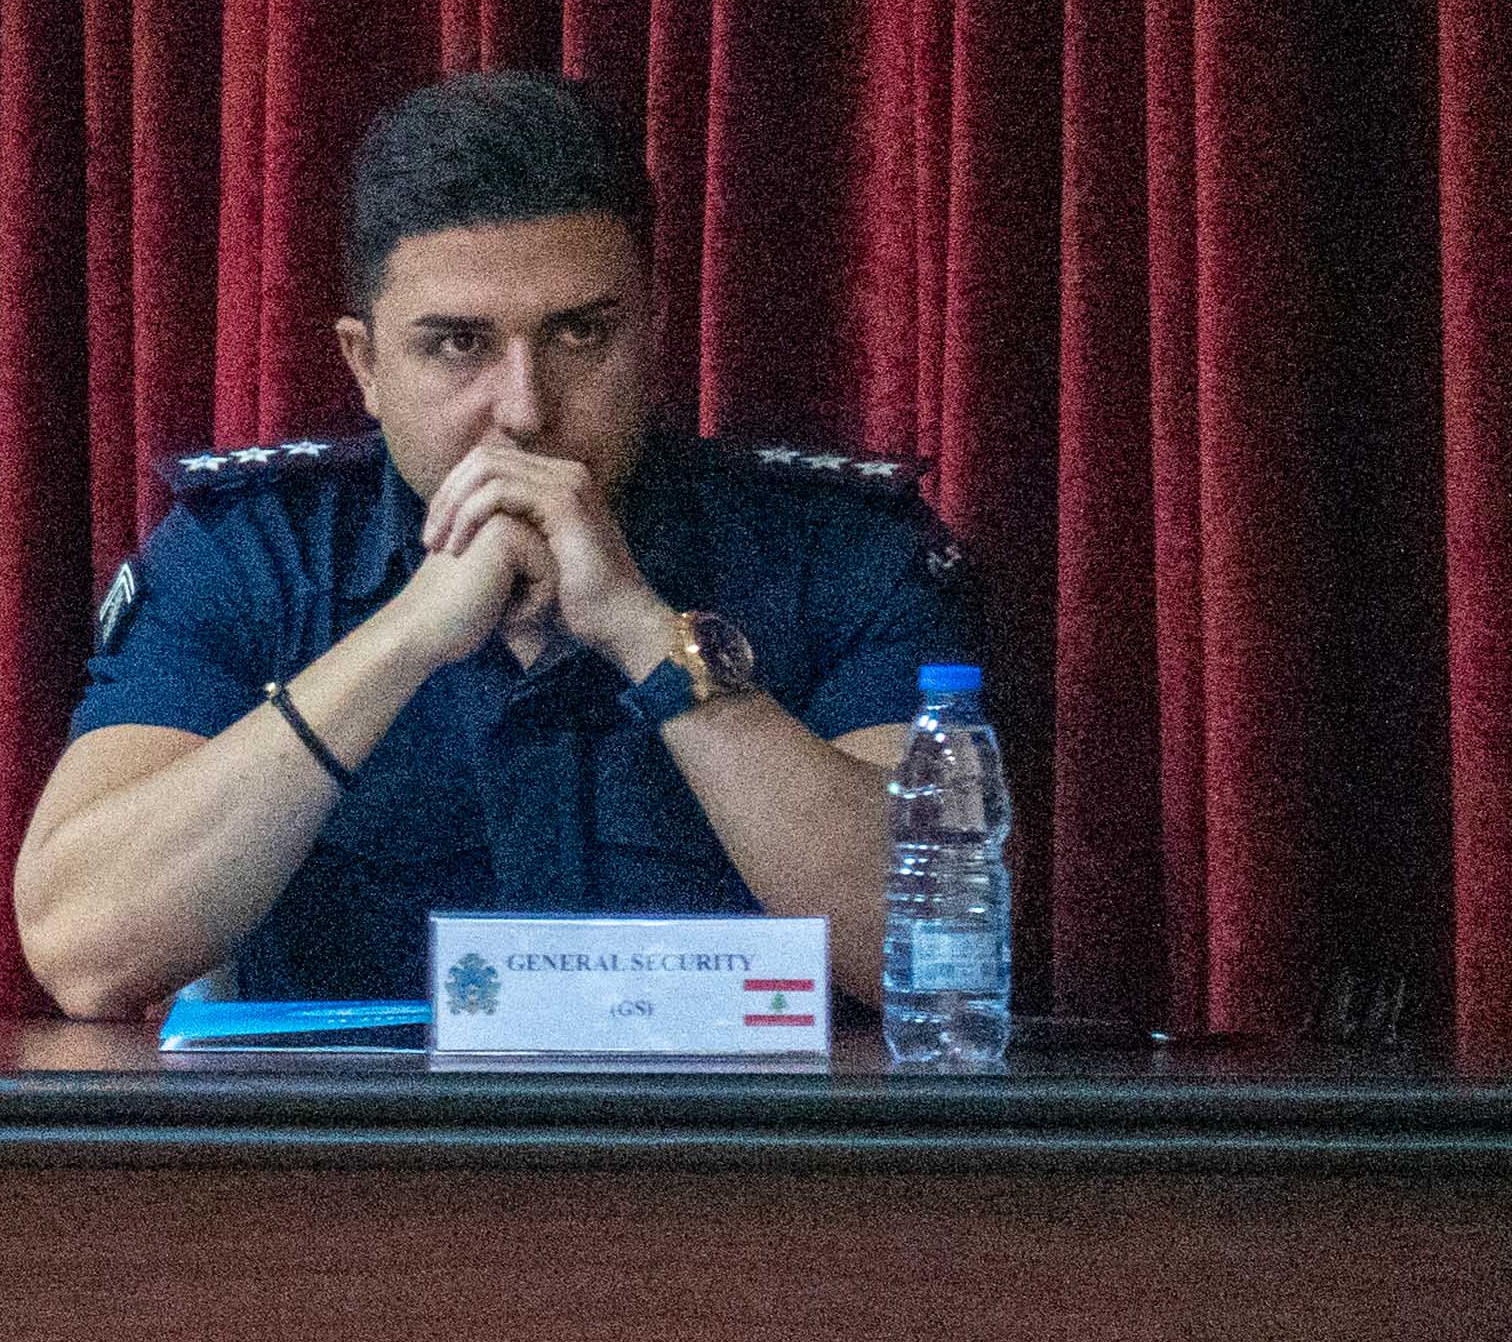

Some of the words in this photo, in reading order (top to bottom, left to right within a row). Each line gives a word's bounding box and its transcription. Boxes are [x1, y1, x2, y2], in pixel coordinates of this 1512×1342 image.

[507, 953, 622, 971] GENERAL
[630, 953, 755, 971] SECURITY
[610, 1000, 655, 1018] (GS)
